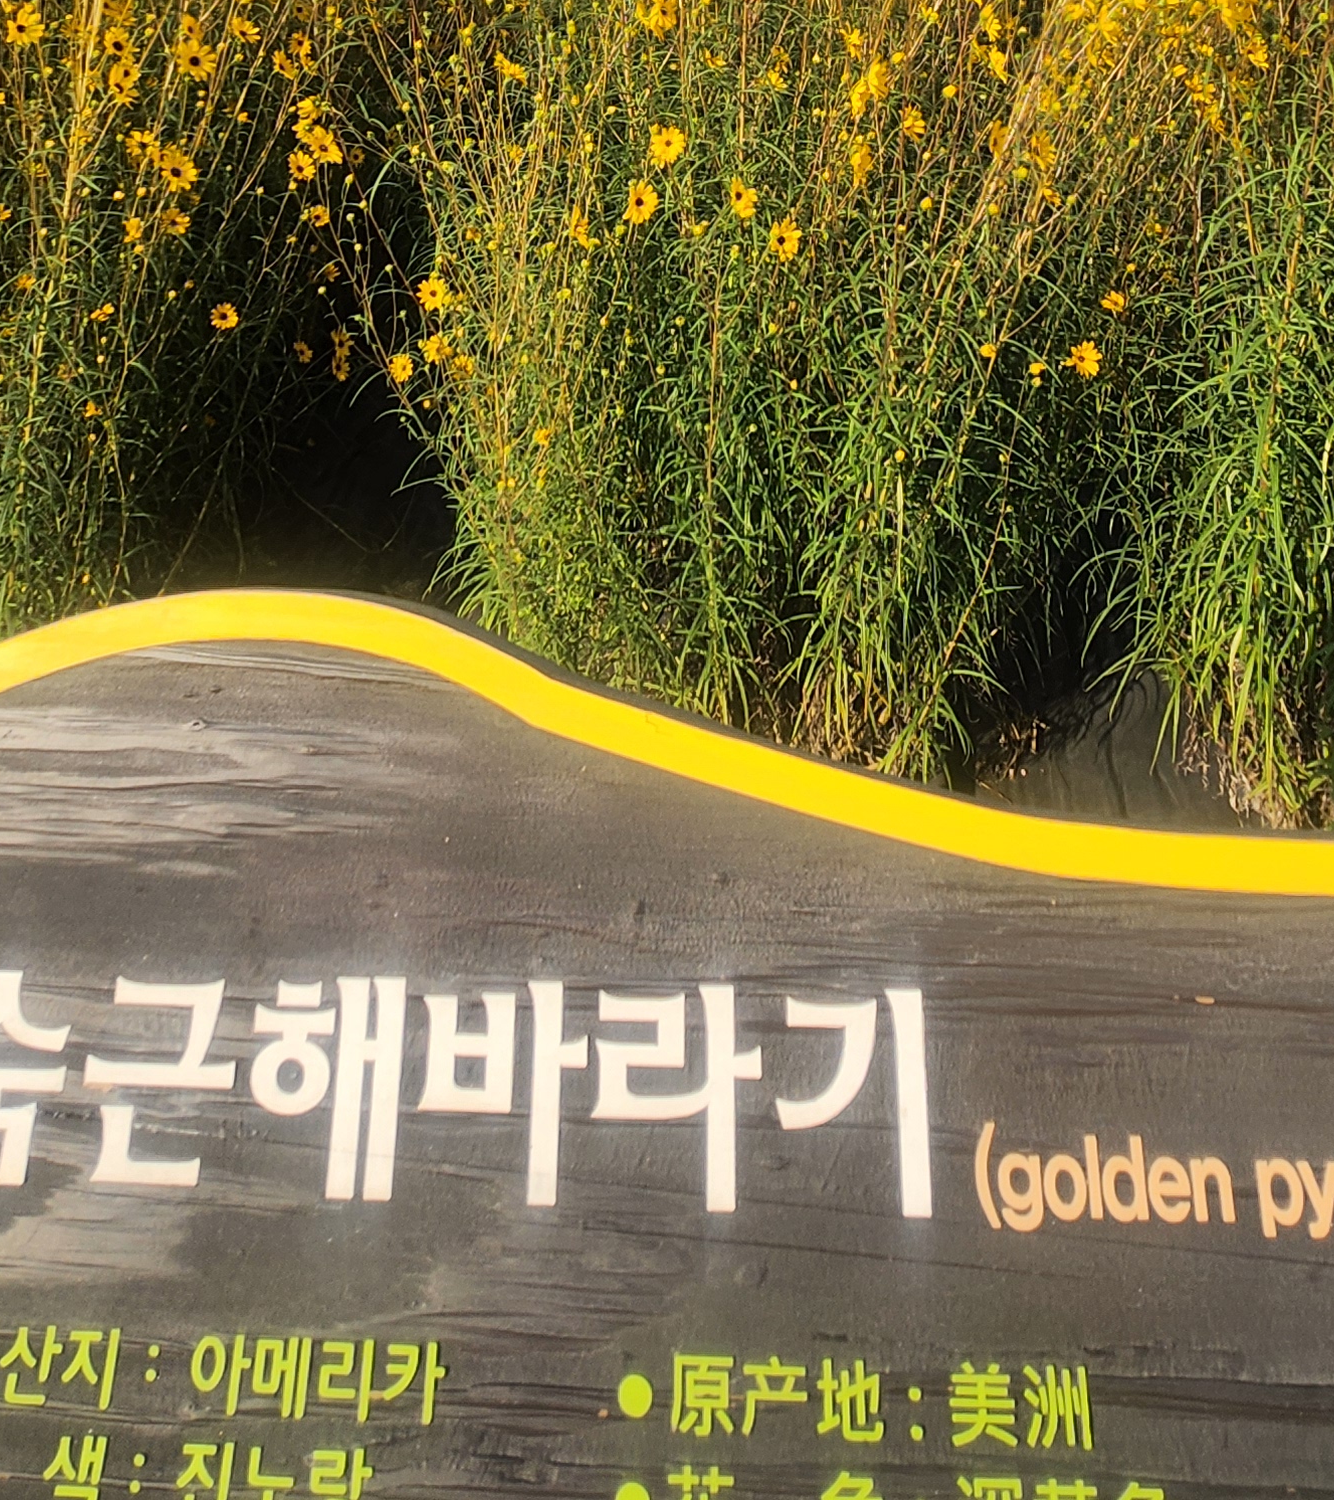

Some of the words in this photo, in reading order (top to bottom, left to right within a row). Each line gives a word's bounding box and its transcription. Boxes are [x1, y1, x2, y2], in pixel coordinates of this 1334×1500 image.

[974, 1120, 1237, 1232] (golden
[188, 1332, 447, 1425] 아메리카
[669, 1351, 885, 1444] 原产地
[947, 1360, 1094, 1451] 美洲
